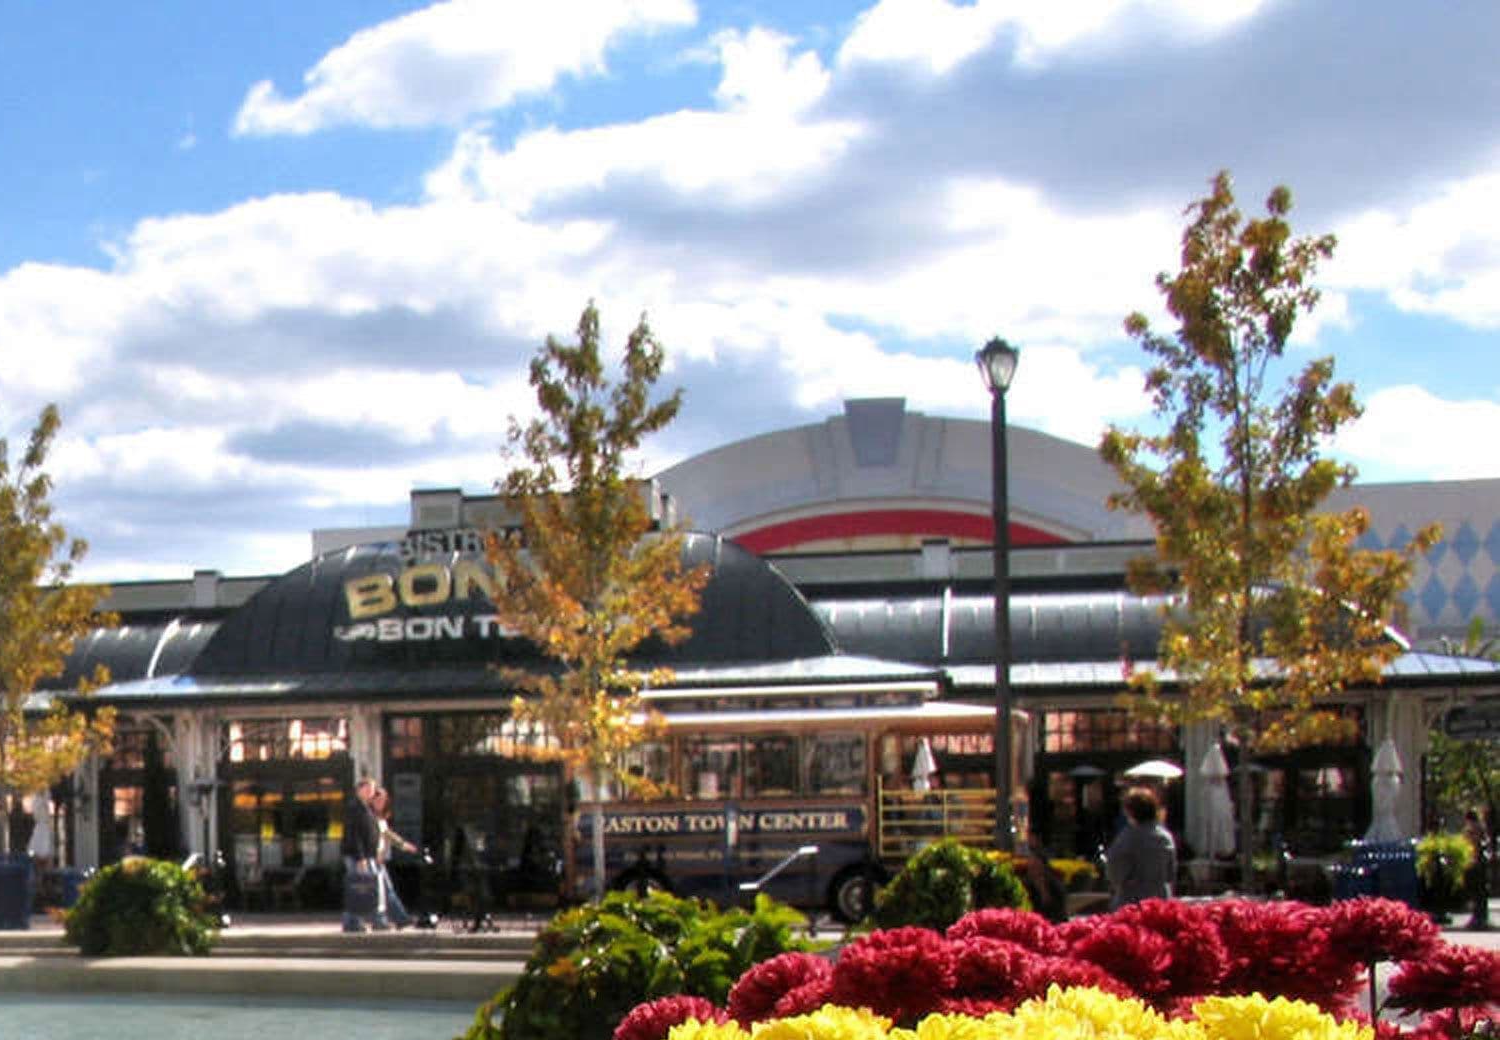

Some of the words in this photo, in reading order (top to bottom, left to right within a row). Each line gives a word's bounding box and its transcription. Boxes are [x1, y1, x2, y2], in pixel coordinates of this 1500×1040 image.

[399, 528, 498, 561] BISTR
[598, 814, 678, 833] ASTON
[758, 811, 848, 832] CENTER
